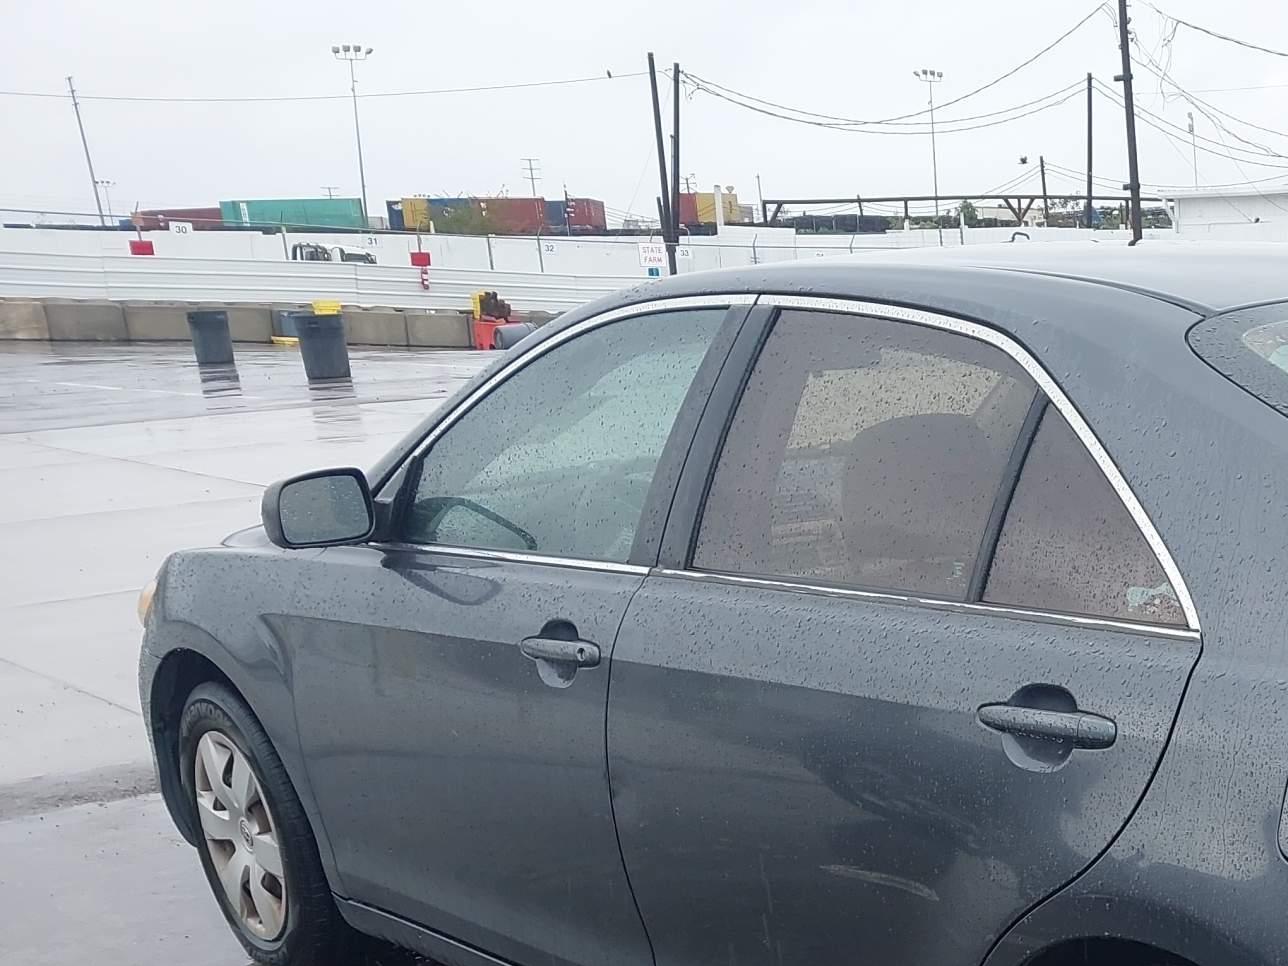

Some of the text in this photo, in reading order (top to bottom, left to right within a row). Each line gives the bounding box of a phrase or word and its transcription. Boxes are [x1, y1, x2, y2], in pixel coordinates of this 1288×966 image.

[175, 225, 187, 234] 30
[367, 237, 378, 246] 31
[544, 244, 554, 252] 32
[642, 246, 663, 254] STATE
[680, 249, 690, 257] 33
[643, 255, 663, 263] FARM
